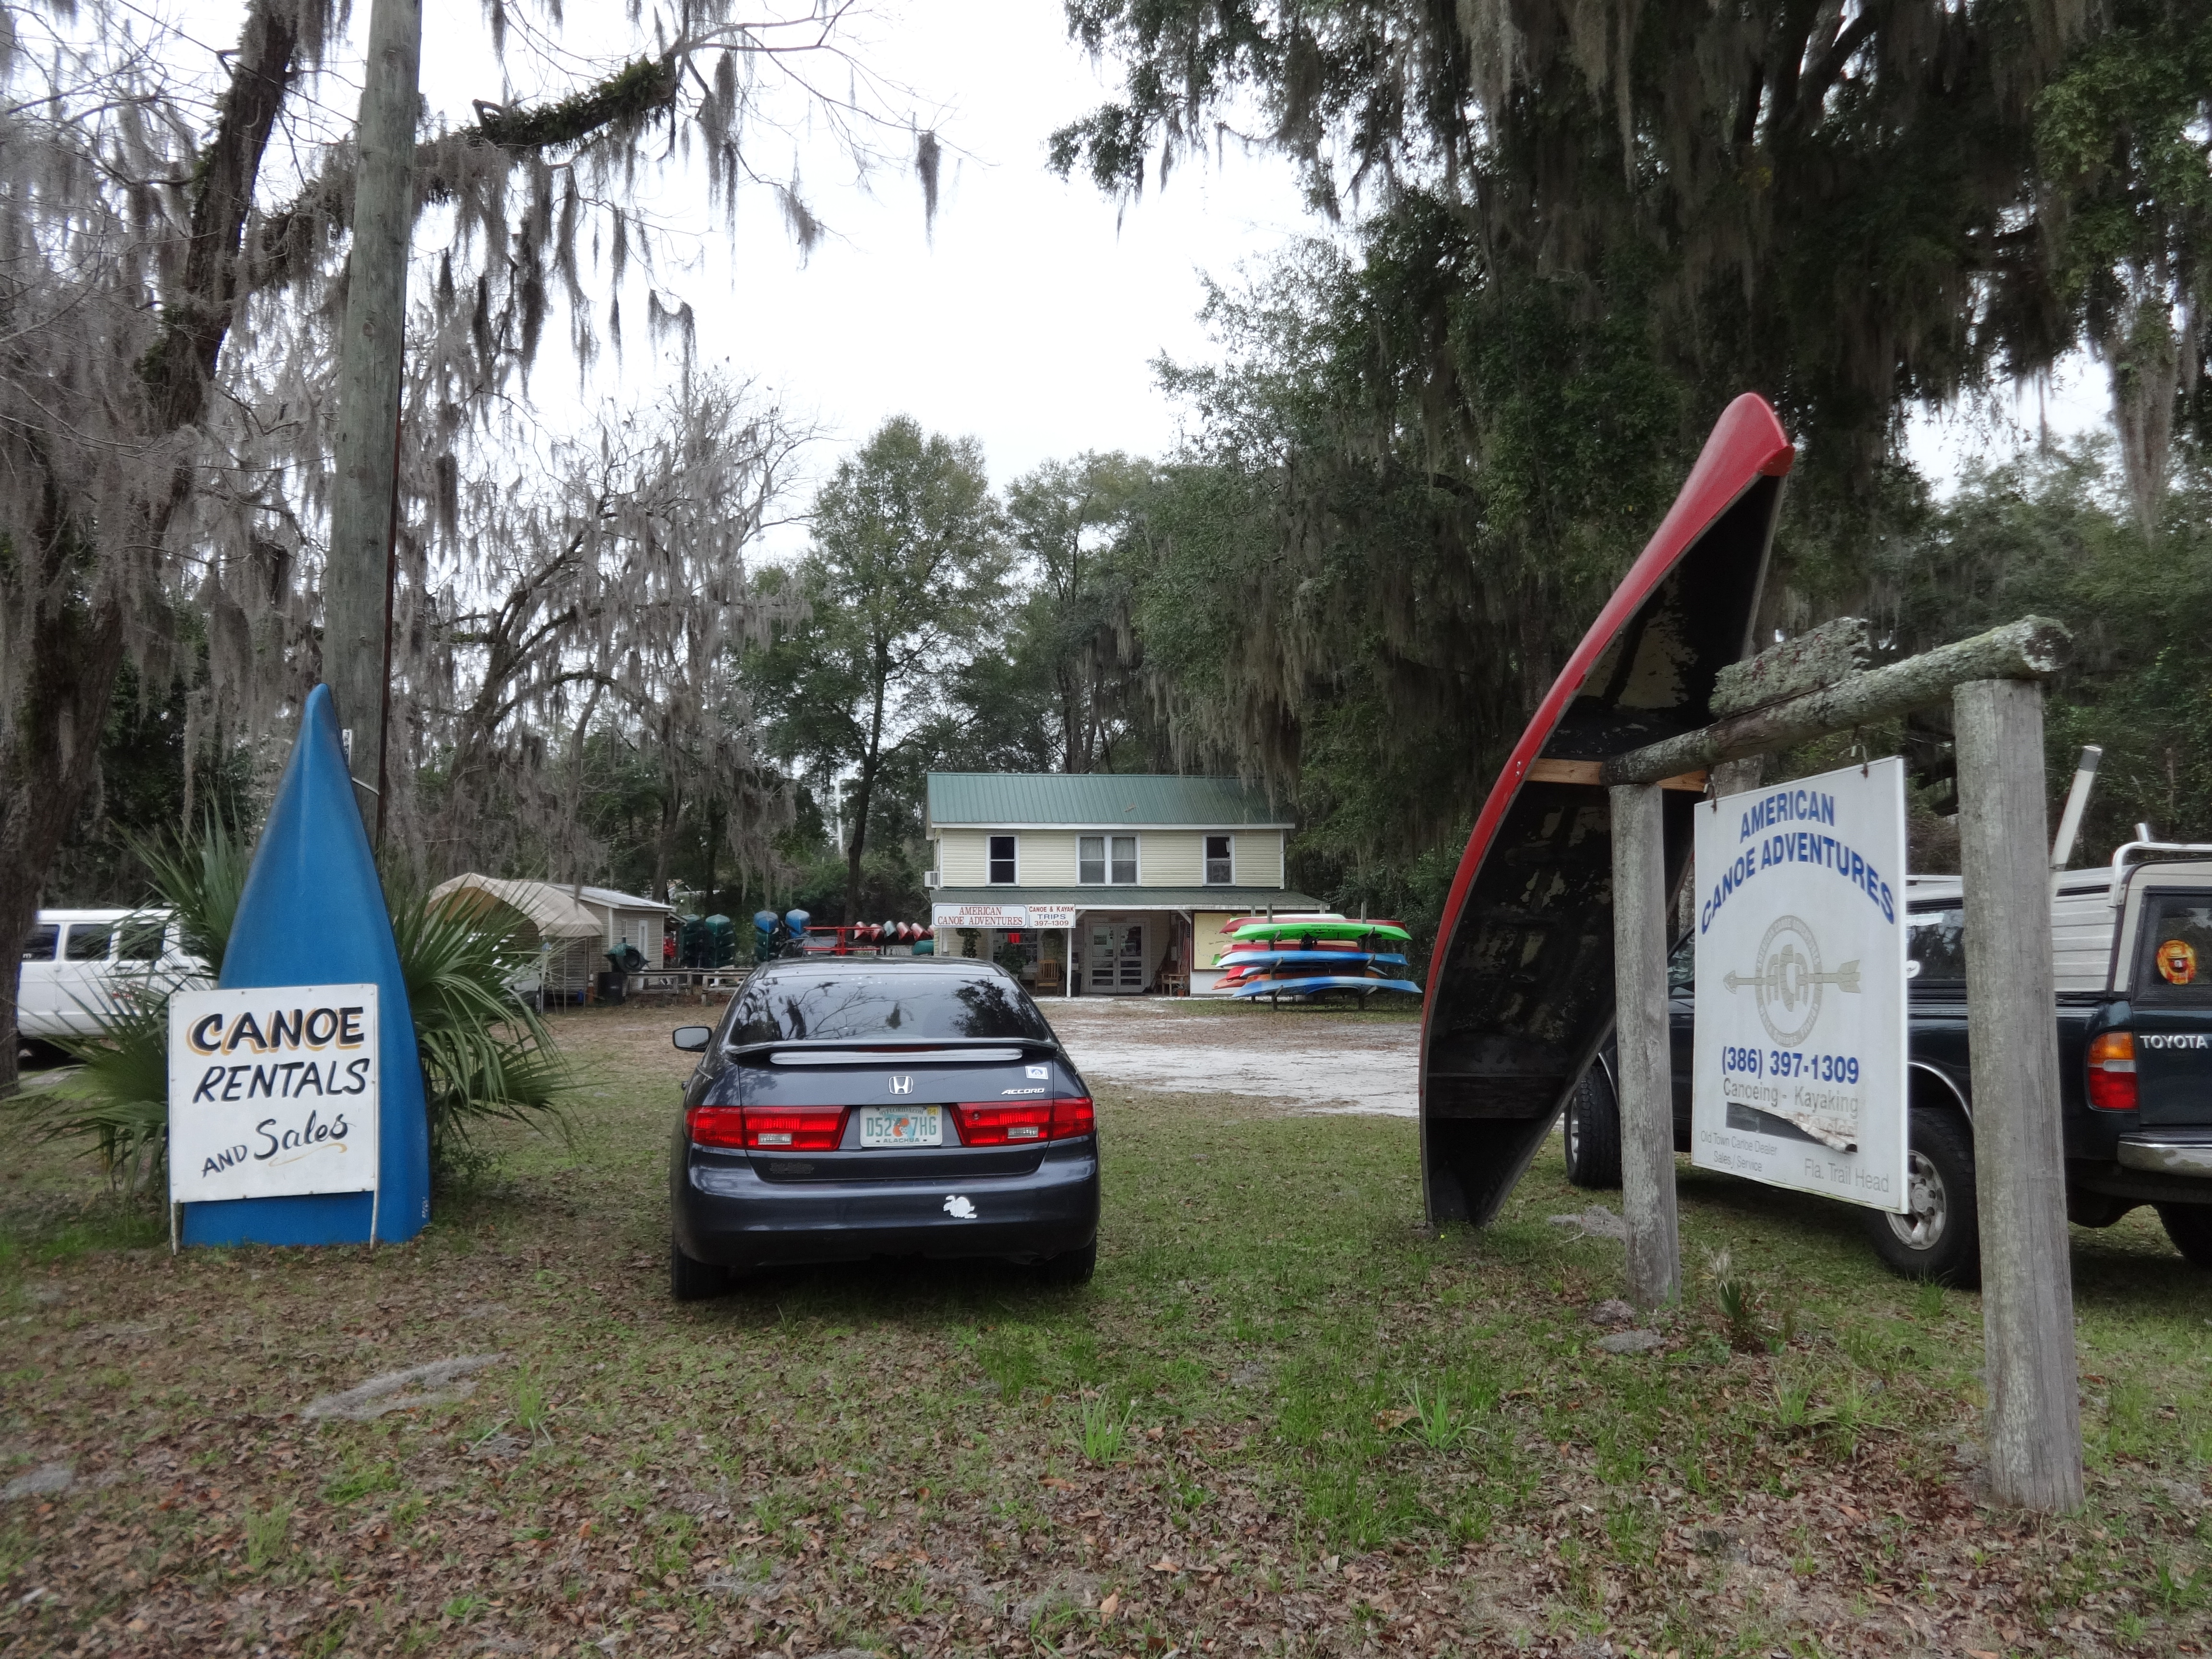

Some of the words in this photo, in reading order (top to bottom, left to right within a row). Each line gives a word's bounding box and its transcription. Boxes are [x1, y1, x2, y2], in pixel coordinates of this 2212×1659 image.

[1740, 790, 1834, 844] AMERICAN
[1701, 847, 1755, 935] CANOE
[1760, 832, 1895, 925] ADVENTURES
[938, 916, 964, 925] CANOE
[969, 916, 1022, 925] ADVENTURES
[959, 907, 1002, 915] AMERICAN
[187, 1006, 364, 1056] CANOE
[2140, 1035, 2209, 1049] TOYOTA
[192, 1058, 370, 1104] RENTALS
[1722, 1046, 1763, 1079] (386)
[1769, 1050, 1859, 1084] 397-1309
[1723, 1078, 1778, 1106] Canoeing
[1794, 1086, 1858, 1119] Kayaking
[201, 1145, 247, 1178] AND
[253, 1110, 354, 1161] Sales
[1701, 1130, 1711, 1143] Old
[1713, 1132, 1729, 1146] Town
[1731, 1136, 1753, 1151] Canoe
[1755, 1141, 1777, 1155] Dealer
[1737, 1155, 1763, 1172] Service
[1804, 1158, 1824, 1179] Fla.
[1827, 1162, 1851, 1185] Trail
[1855, 1167, 1889, 1192] Head
